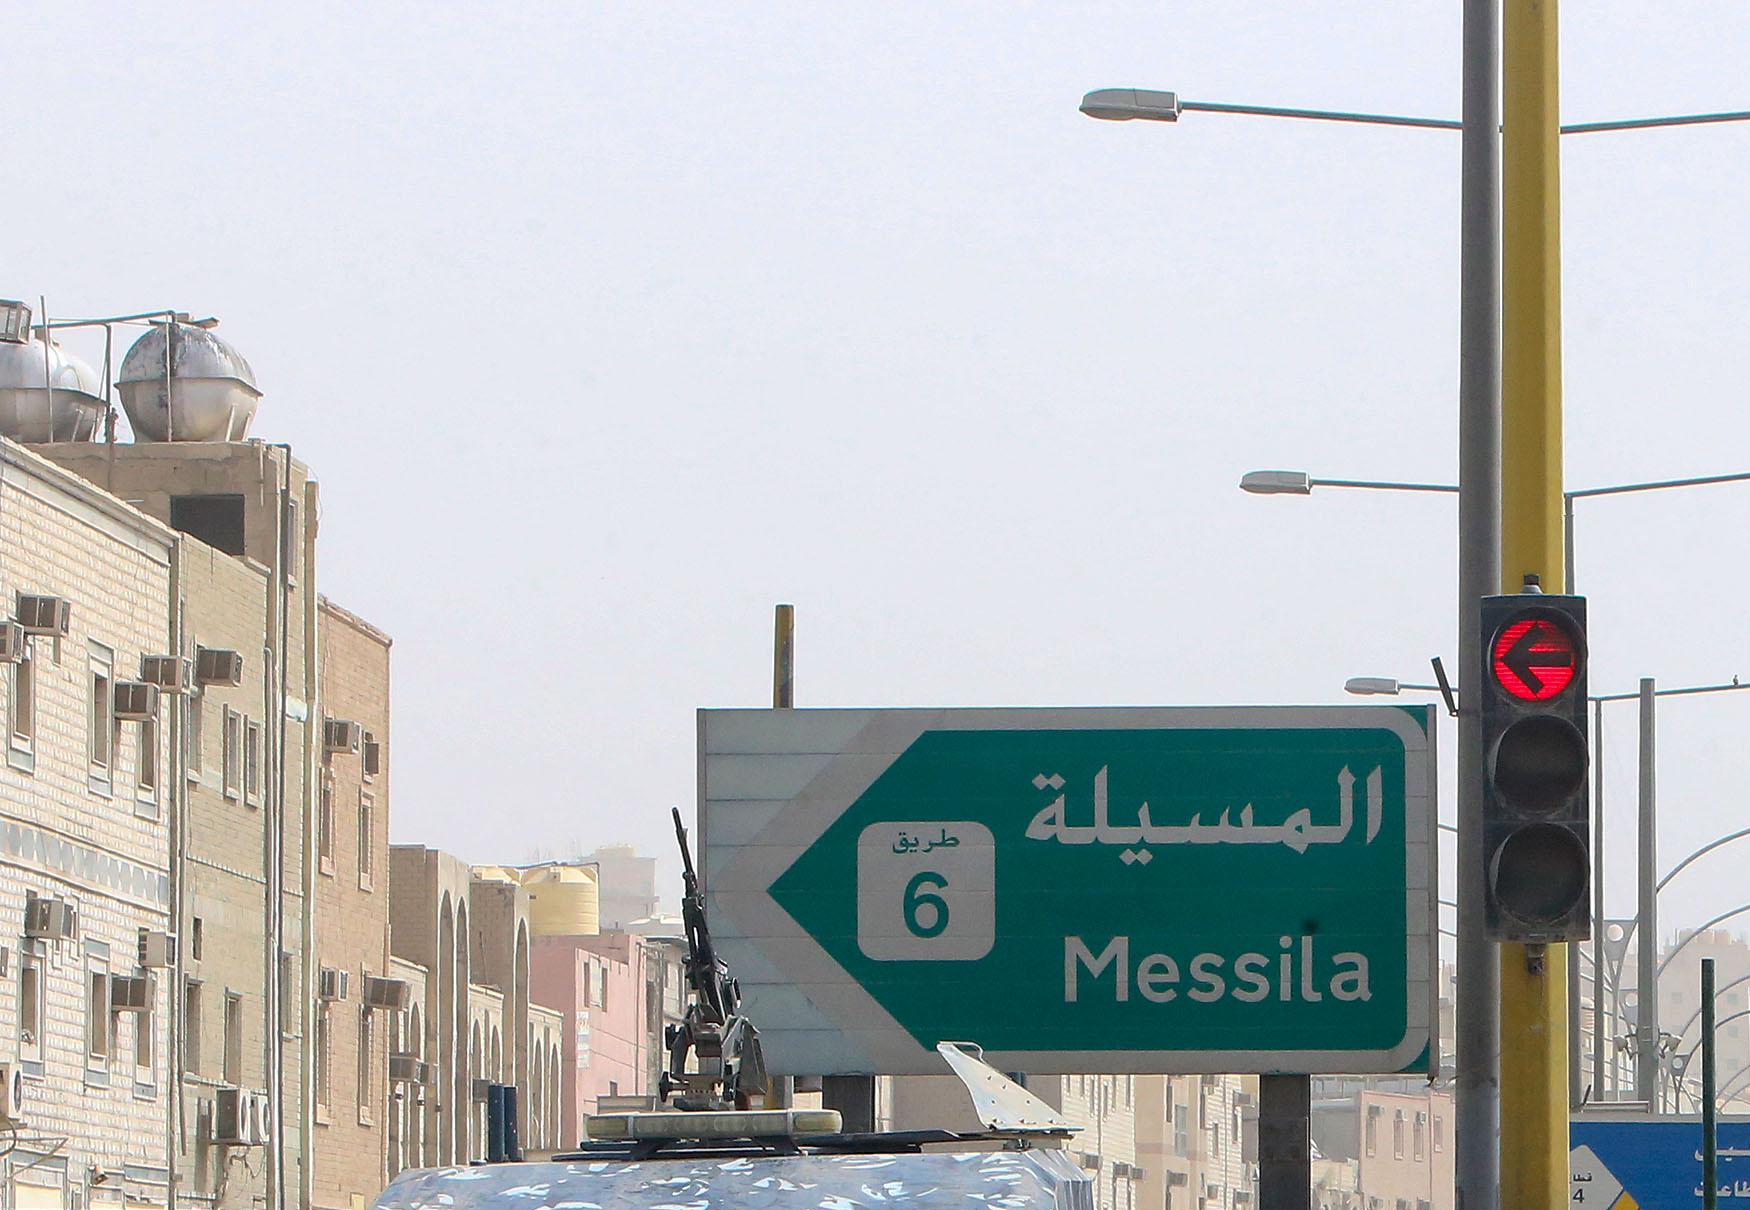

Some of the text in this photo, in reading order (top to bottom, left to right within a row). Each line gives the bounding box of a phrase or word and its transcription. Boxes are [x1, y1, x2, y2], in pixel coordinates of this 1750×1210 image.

[891, 831, 961, 854] طريق
[1025, 763, 1383, 866] المسيلة
[902, 871, 950, 939] 6
[1064, 934, 1374, 1003] Messila
[1572, 1188, 1585, 1204] 4
